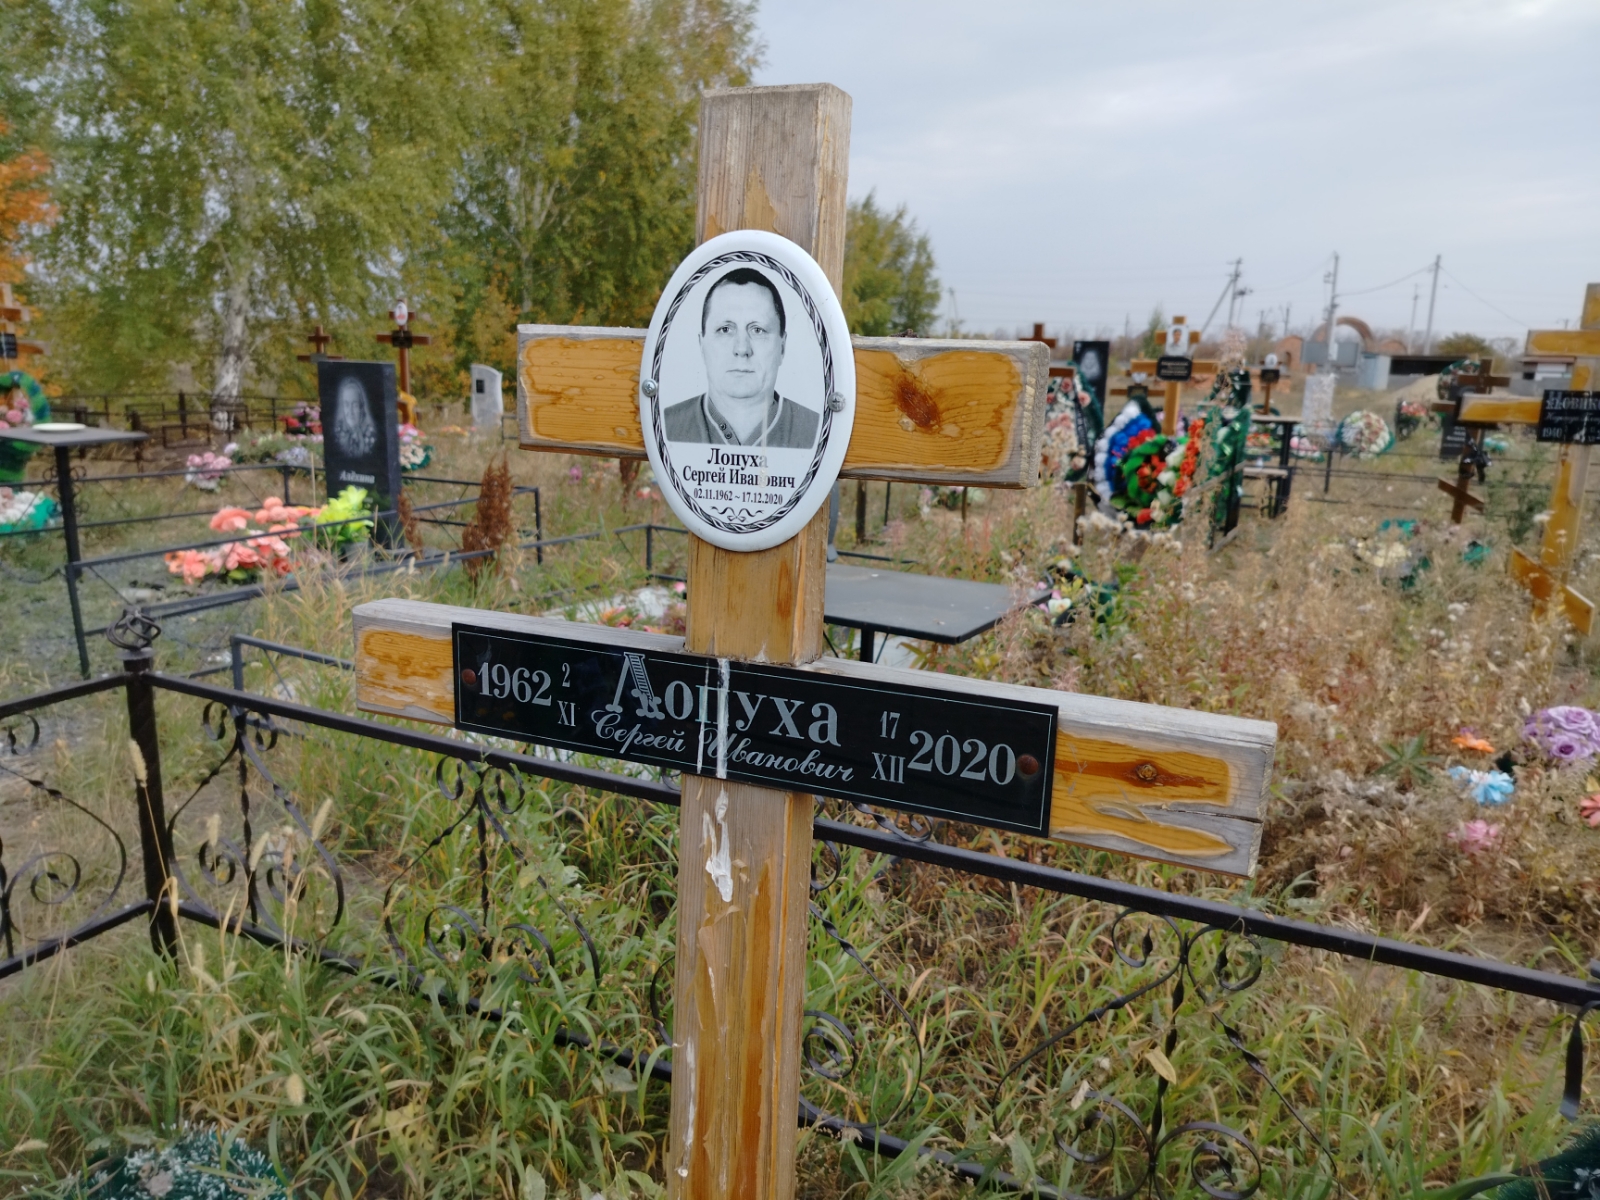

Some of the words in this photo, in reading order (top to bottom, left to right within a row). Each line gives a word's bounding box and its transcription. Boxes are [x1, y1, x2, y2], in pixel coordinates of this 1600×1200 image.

[1546, 391, 1600, 410] Новик
[707, 448, 768, 470] Лопуха
[682, 465, 726, 486] Сергей
[693, 488, 733, 501] 02.11.1962
[742, 491, 783, 505] 17.12.2020
[478, 662, 551, 706] 1962
[561, 662, 571, 687] 2
[605, 652, 841, 746] Лопуха
[879, 711, 900, 739] 17
[591, 709, 686, 753] Сергей
[702, 727, 854, 782] Иванович
[907, 730, 1016, 785] 2020
